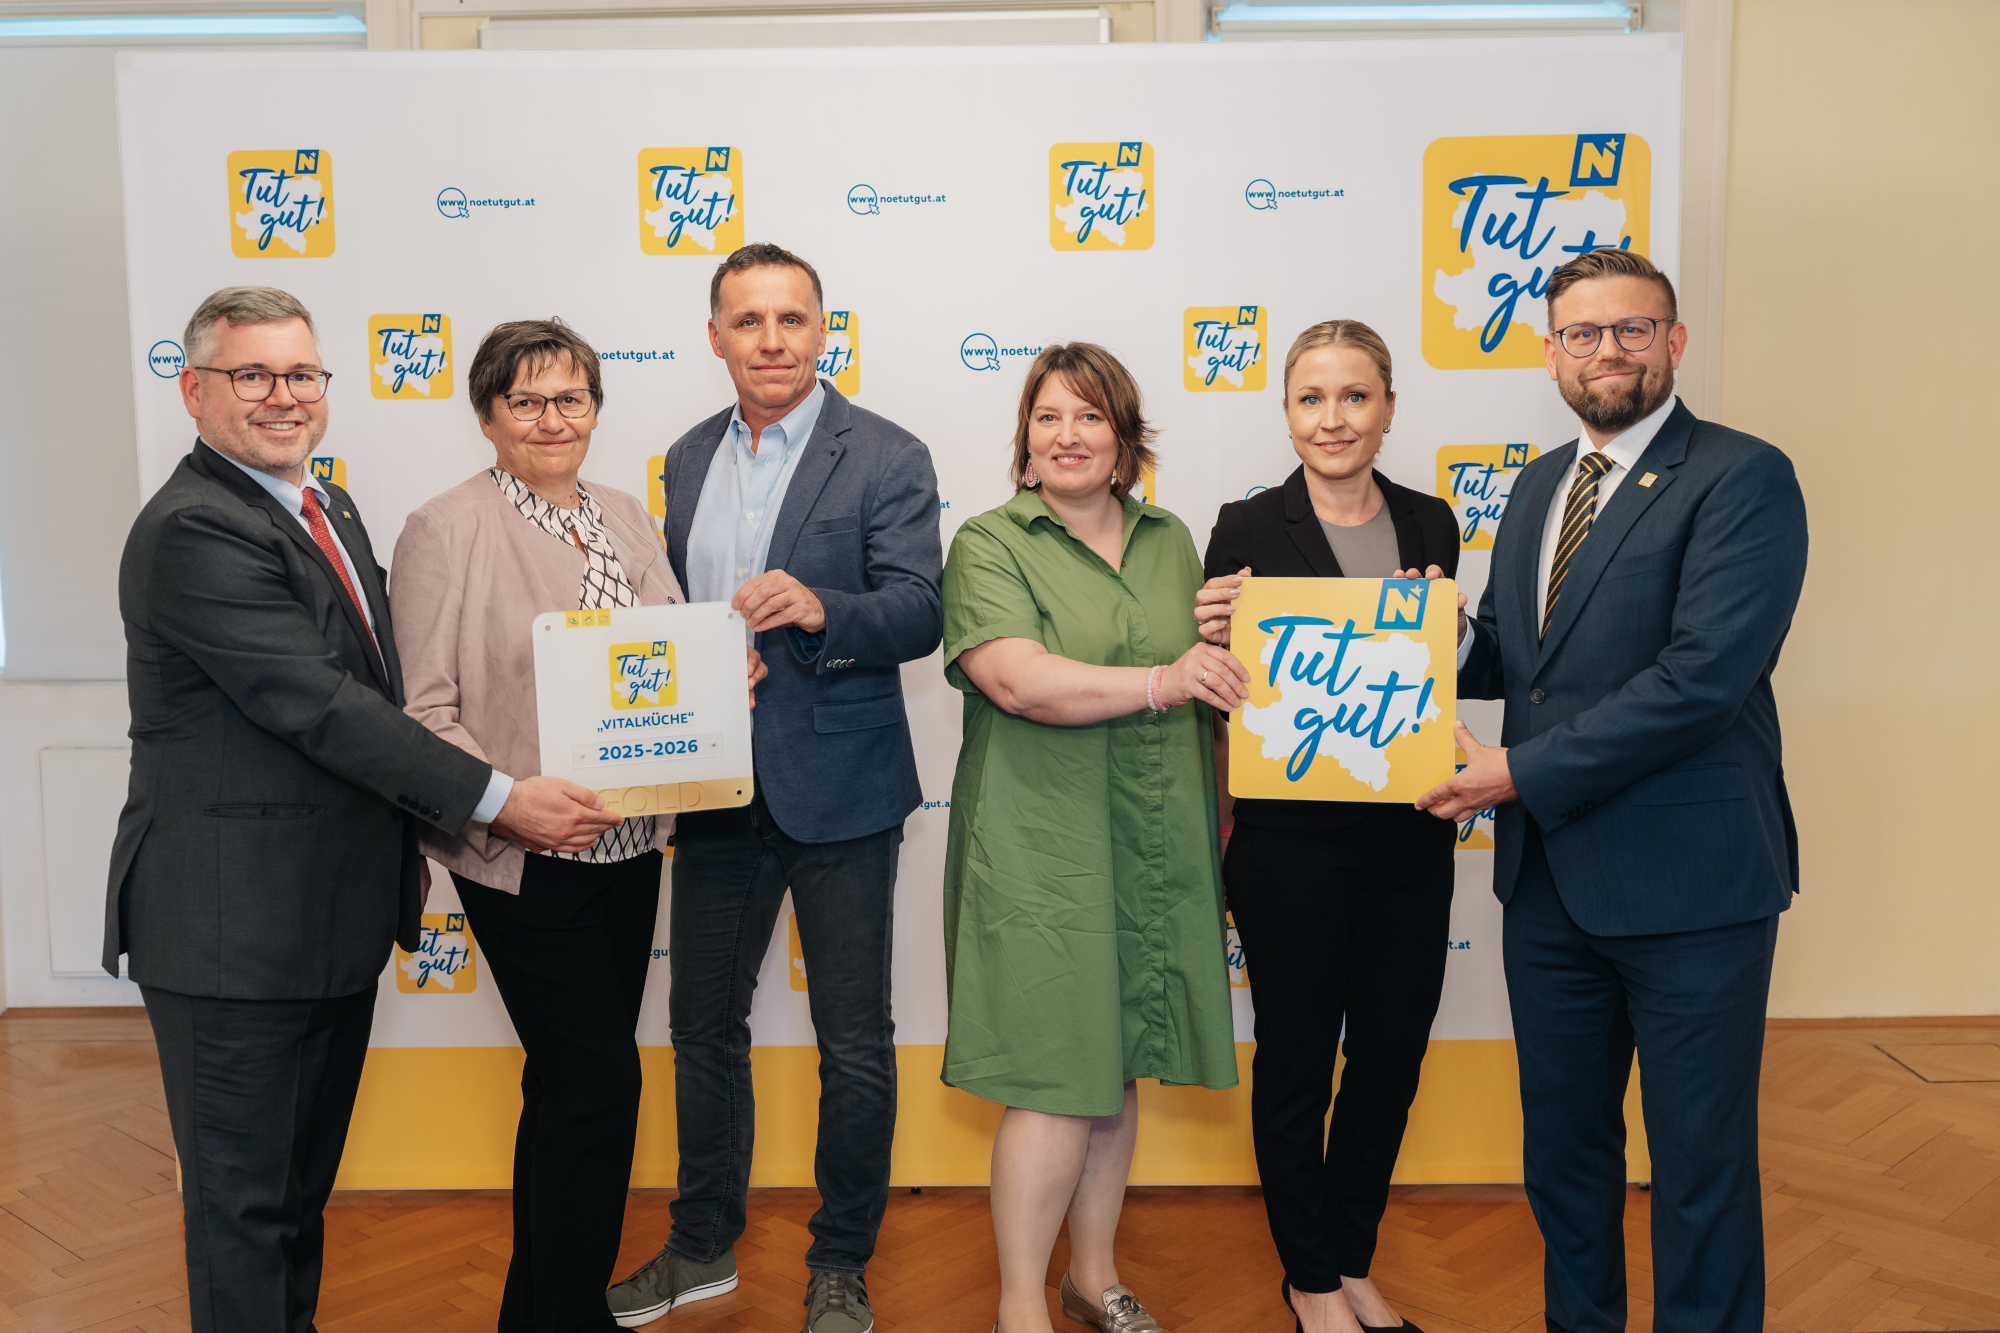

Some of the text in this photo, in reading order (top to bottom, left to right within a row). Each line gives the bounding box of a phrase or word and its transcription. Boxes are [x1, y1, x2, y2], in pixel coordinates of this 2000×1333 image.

[239, 168, 294, 208] Tut
[649, 165, 705, 205] Tut
[1060, 160, 1117, 200] Tut
[1278, 189, 1344, 199] noetutgut.at
[469, 198, 535, 209] noetutgut.at
[880, 194, 946, 204] noetutgut.at
[1077, 186, 1146, 244] gut!
[1448, 174, 1570, 260] Tut
[258, 193, 325, 251] gut!
[667, 191, 735, 248] gut!
[377, 328, 420, 359] Tut
[963, 348, 995, 356] www
[1193, 320, 1237, 352] Tut
[151, 356, 183, 364] www
[392, 348, 446, 394] gut!
[816, 346, 853, 377] ut!
[1206, 340, 1261, 386] gut!
[1448, 462, 1503, 501] Tut
[616, 654, 651, 677] Tut
[1257, 615, 1375, 697] Tut
[628, 669, 671, 704] gut!
[1286, 670, 1435, 782] gut!
[599, 740, 698, 761] 2025-2026
[597, 781, 706, 815] GOLD
[418, 927, 447, 957] ut
[417, 946, 469, 988] gut!
